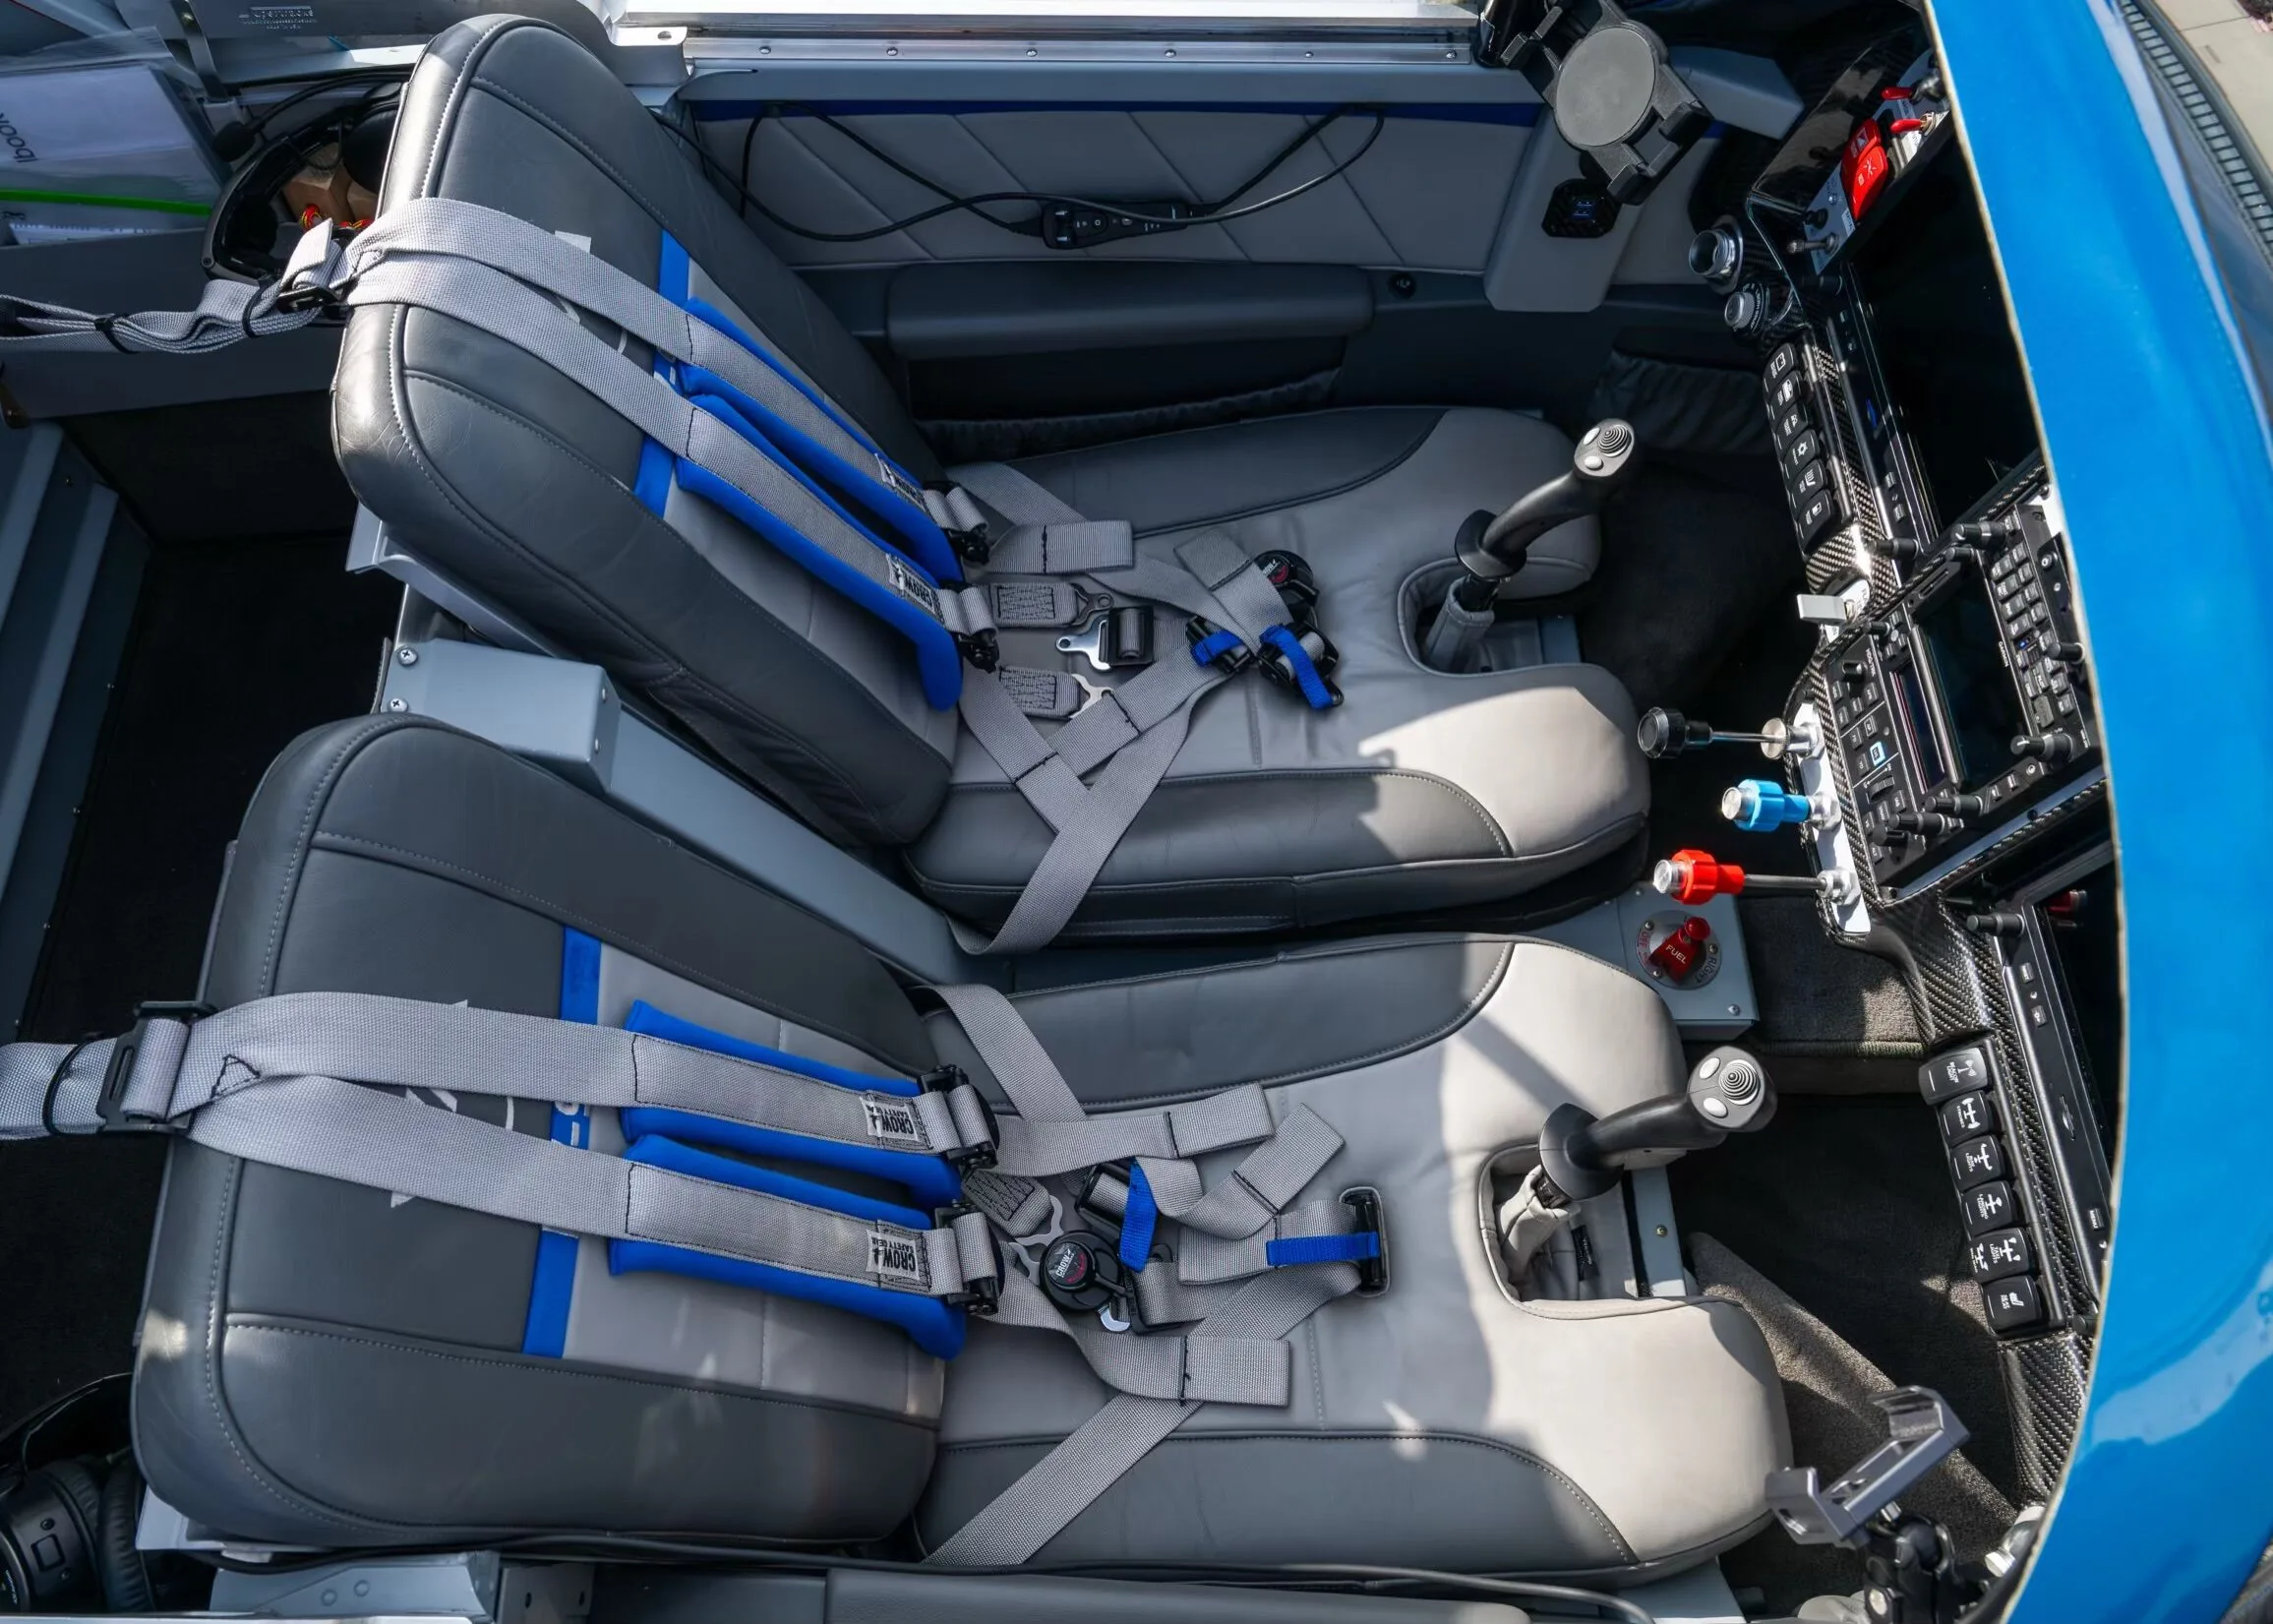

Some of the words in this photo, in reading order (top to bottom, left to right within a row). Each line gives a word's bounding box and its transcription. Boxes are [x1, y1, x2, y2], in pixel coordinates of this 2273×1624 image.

[1999, 640, 2009, 667] GARMIN
[1665, 944, 1688, 965] FUEL
[1695, 956, 1718, 984] RIGHT
[881, 1115, 914, 1135] CROW
[1956, 1105, 1966, 1129] STROBES
[2089, 1208, 2098, 1230] MENU
[888, 1240, 915, 1254] SAFETY
[882, 1247, 916, 1272] CROW
[1055, 1254, 1071, 1277] CROW
